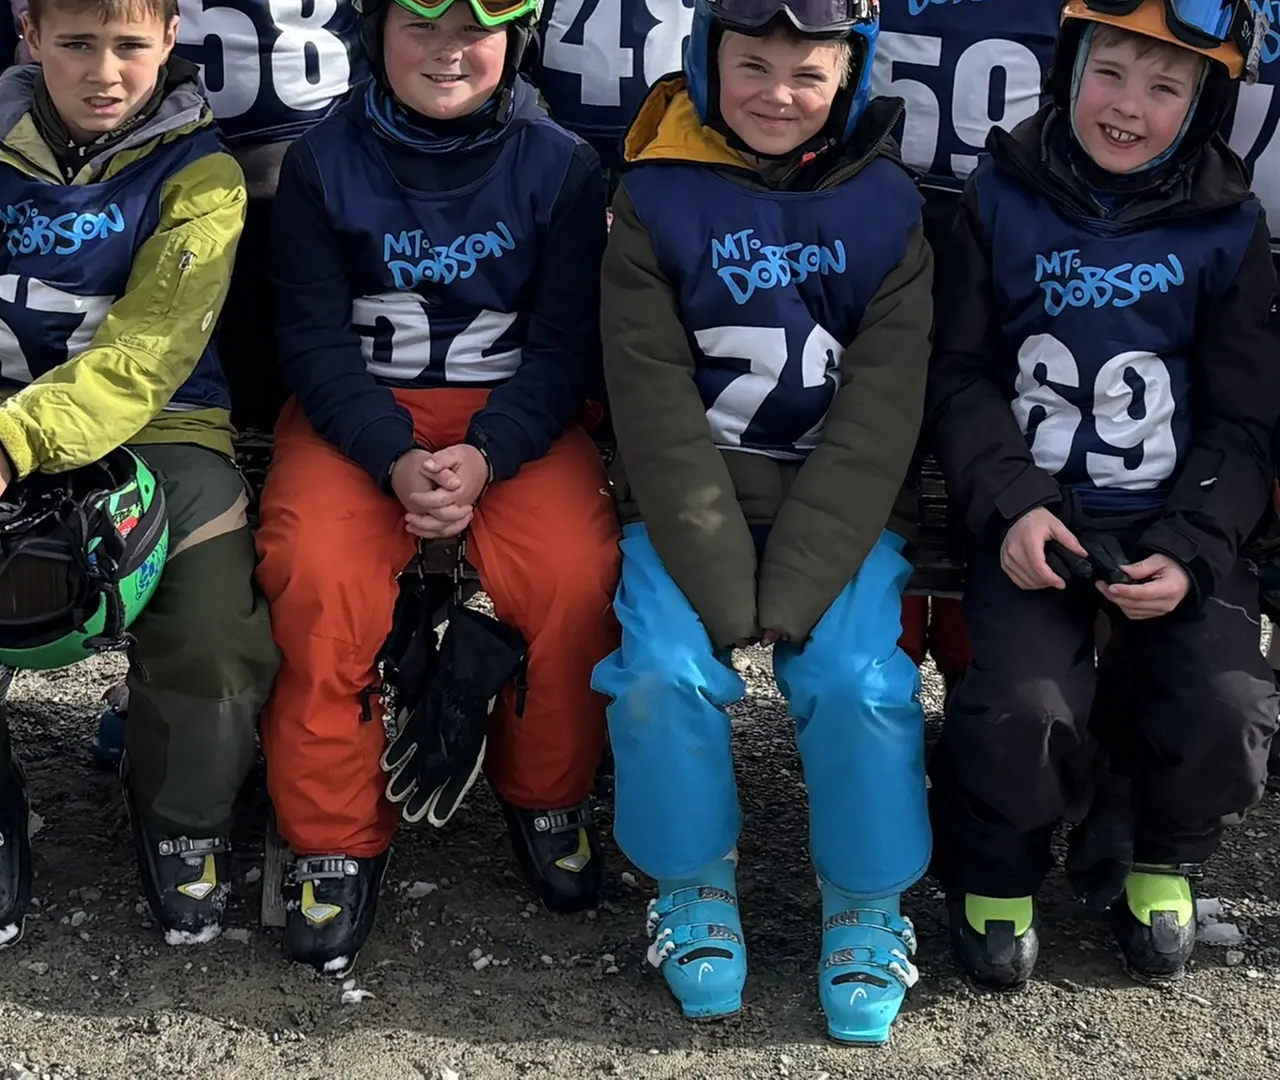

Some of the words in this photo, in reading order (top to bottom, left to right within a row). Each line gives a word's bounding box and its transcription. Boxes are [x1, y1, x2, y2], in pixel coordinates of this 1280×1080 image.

[869, 30, 1042, 180] 59
[5, 203, 125, 256] DOBSON
[387, 221, 516, 290] DOBSON
[717, 239, 847, 305] DOBSON
[1039, 253, 1185, 317] DOBSON
[1010, 332, 1177, 491] 69
